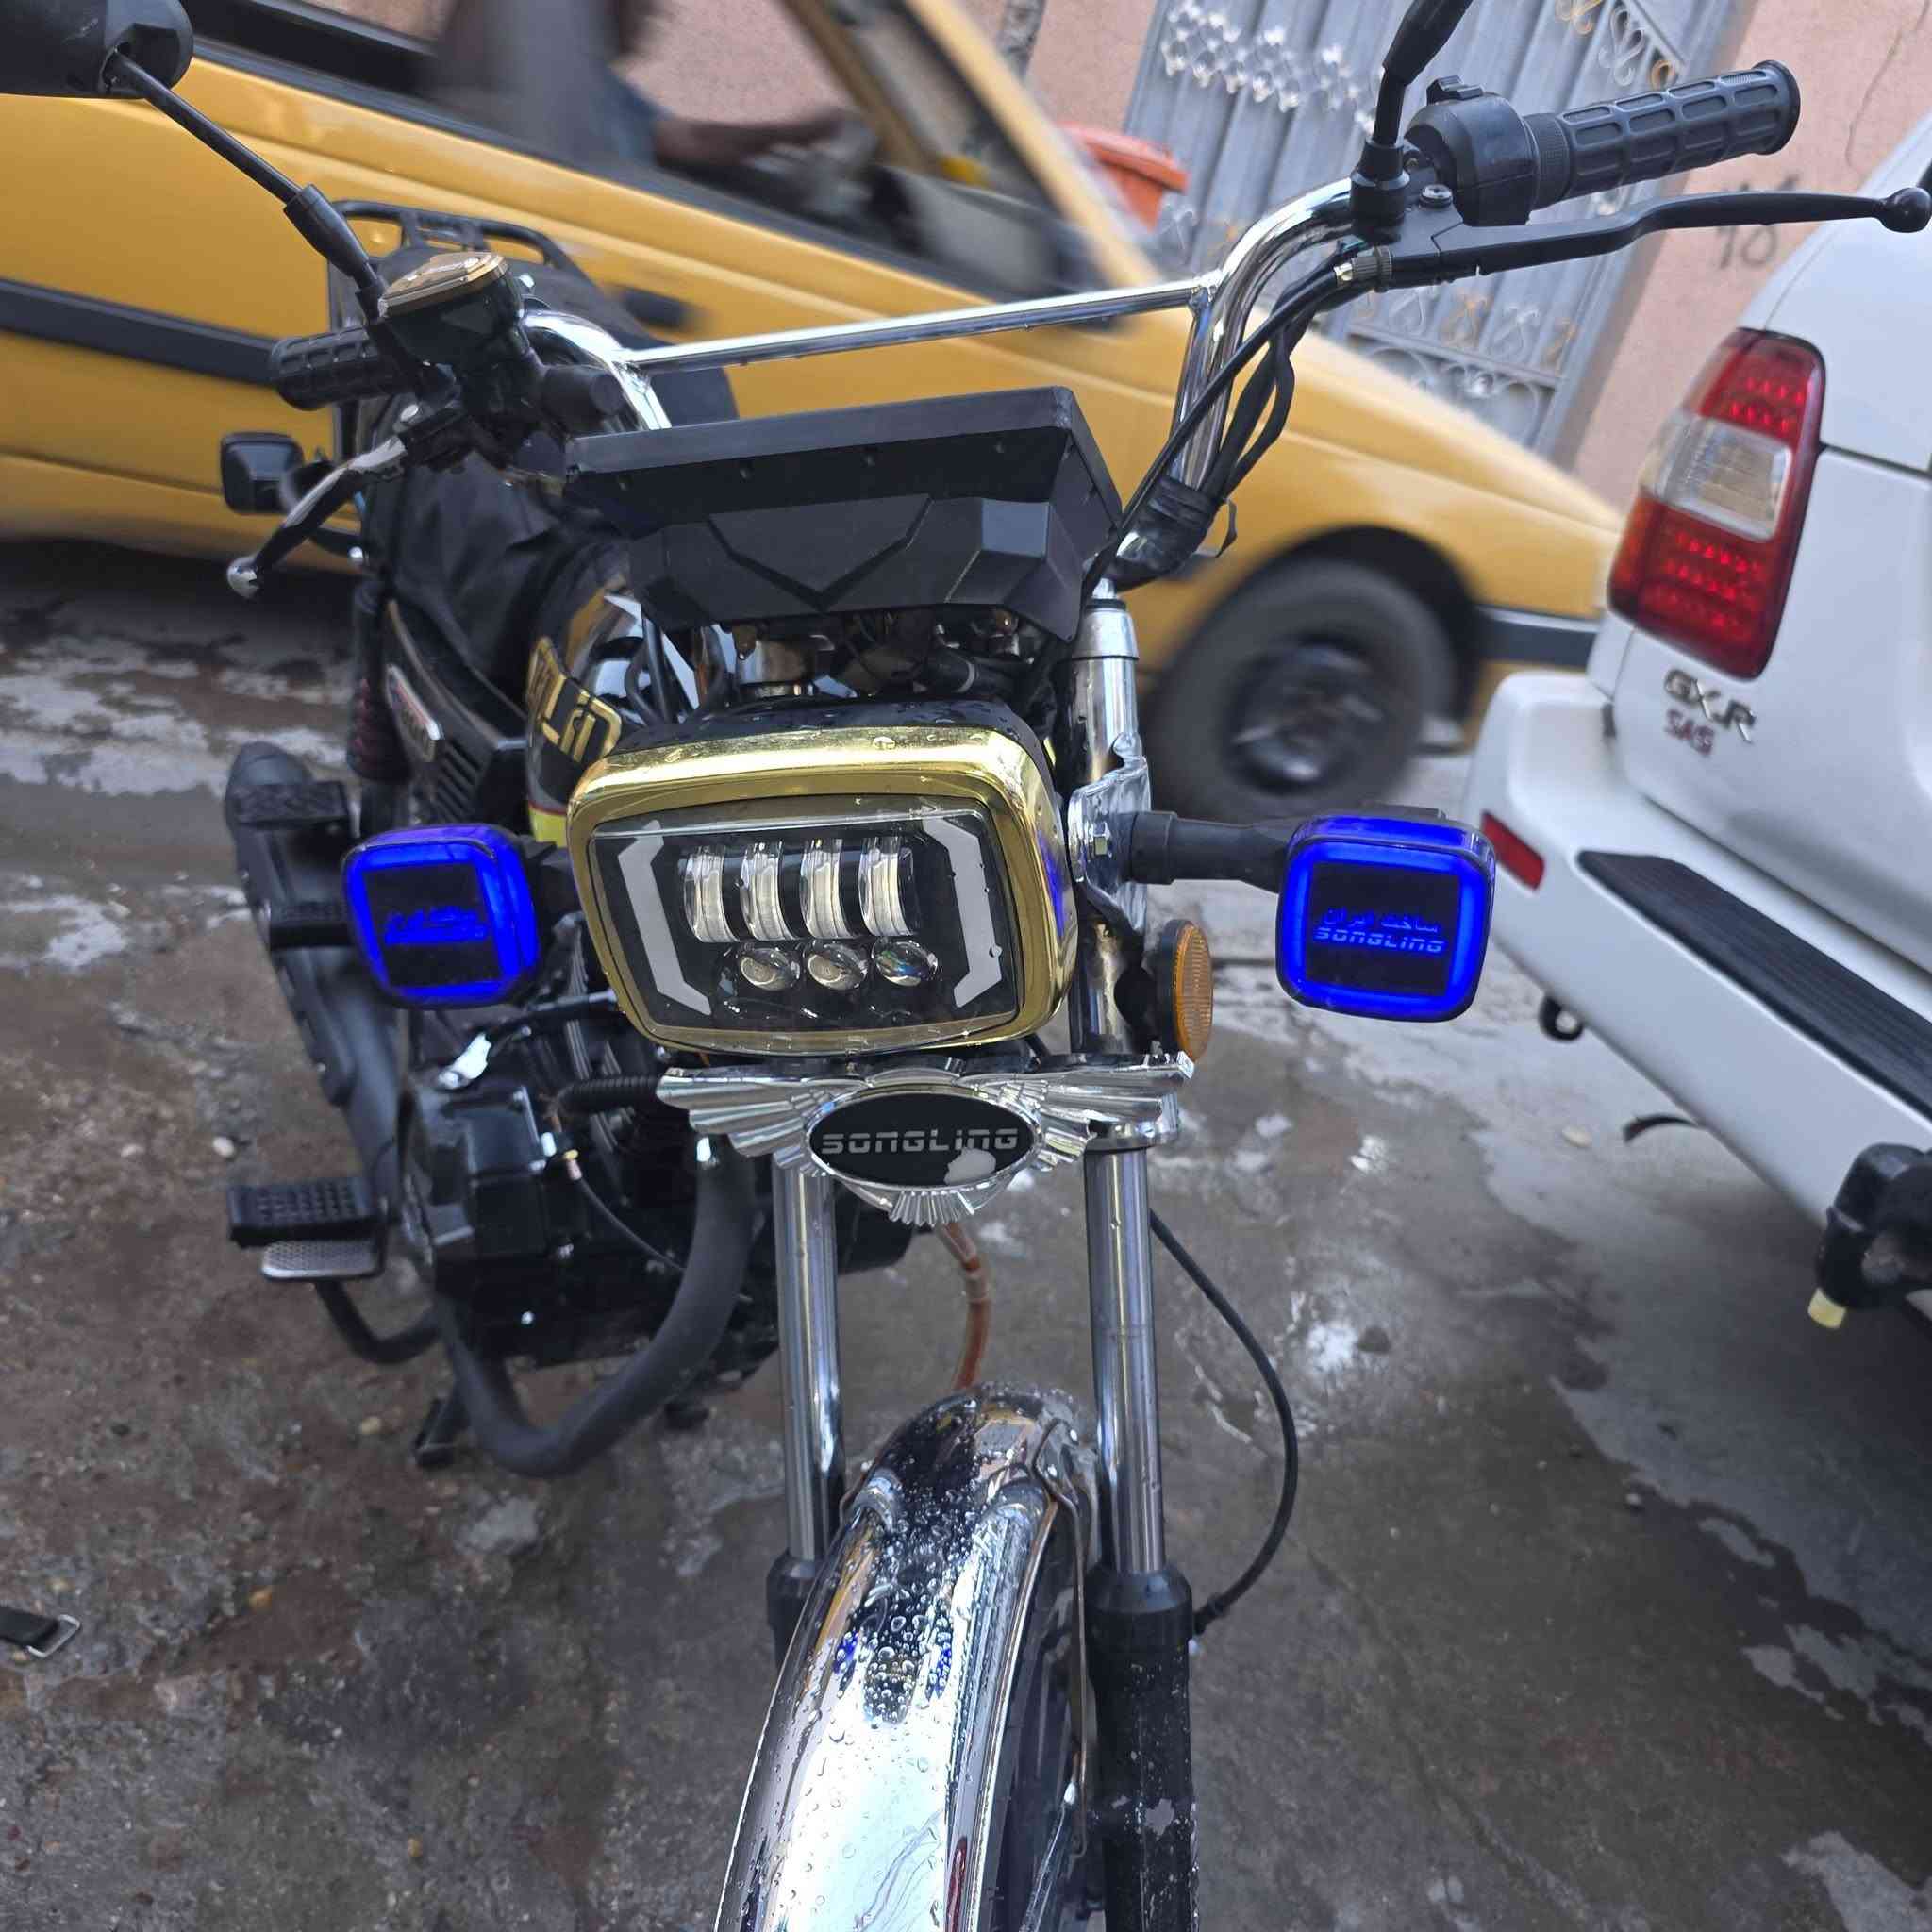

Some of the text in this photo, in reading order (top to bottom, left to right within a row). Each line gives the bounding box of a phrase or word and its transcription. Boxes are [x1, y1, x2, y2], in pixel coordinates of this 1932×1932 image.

[1664, 668, 1757, 744] GXR
[1313, 926, 1446, 953] SONGLING
[821, 1127, 1019, 1155] SONGLING
